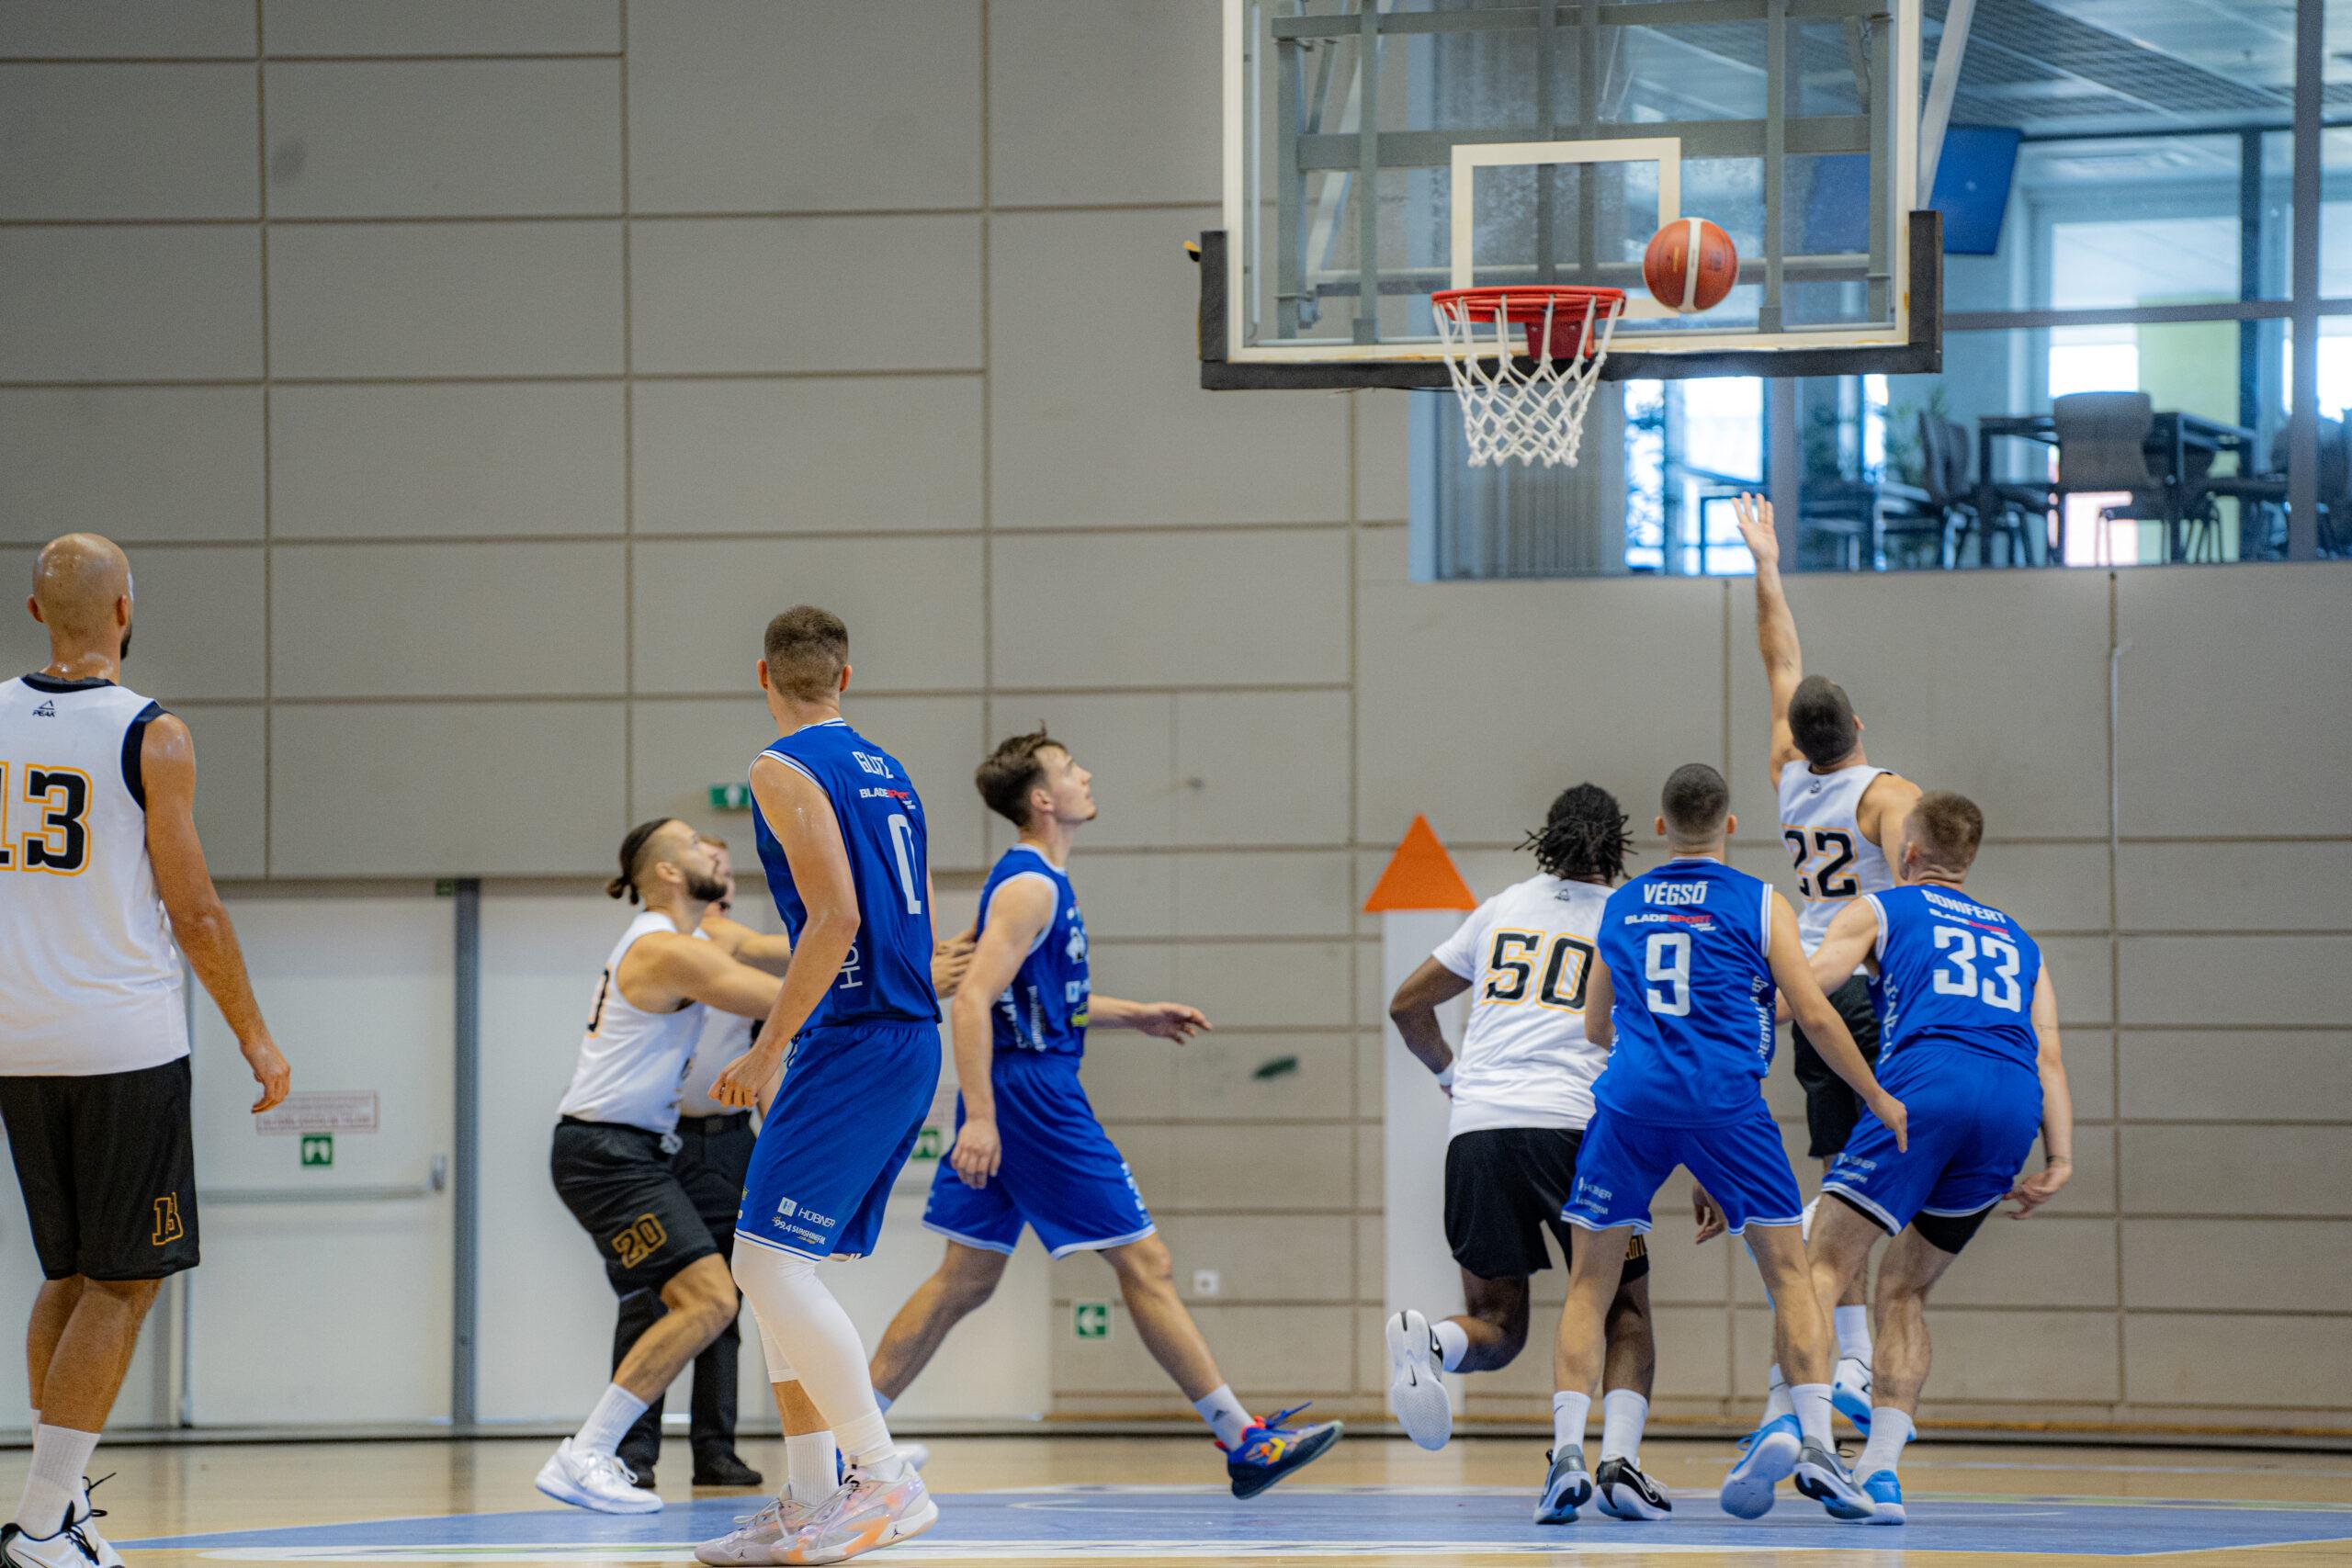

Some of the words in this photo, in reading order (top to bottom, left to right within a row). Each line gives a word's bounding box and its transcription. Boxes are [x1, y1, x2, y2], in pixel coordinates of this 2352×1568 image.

[1781, 823, 1862, 902] 22
[1624, 913, 1713, 925] BLADESPORT
[1644, 881, 1709, 906] VÉGSŐ
[1920, 889, 2007, 924] BONIFERT
[1481, 928, 1596, 1014] 50
[1645, 932, 1691, 1017] 9
[1933, 925, 2022, 1012] 33
[611, 1213, 668, 1269] 20
[773, 1218, 793, 1233] 99.4
